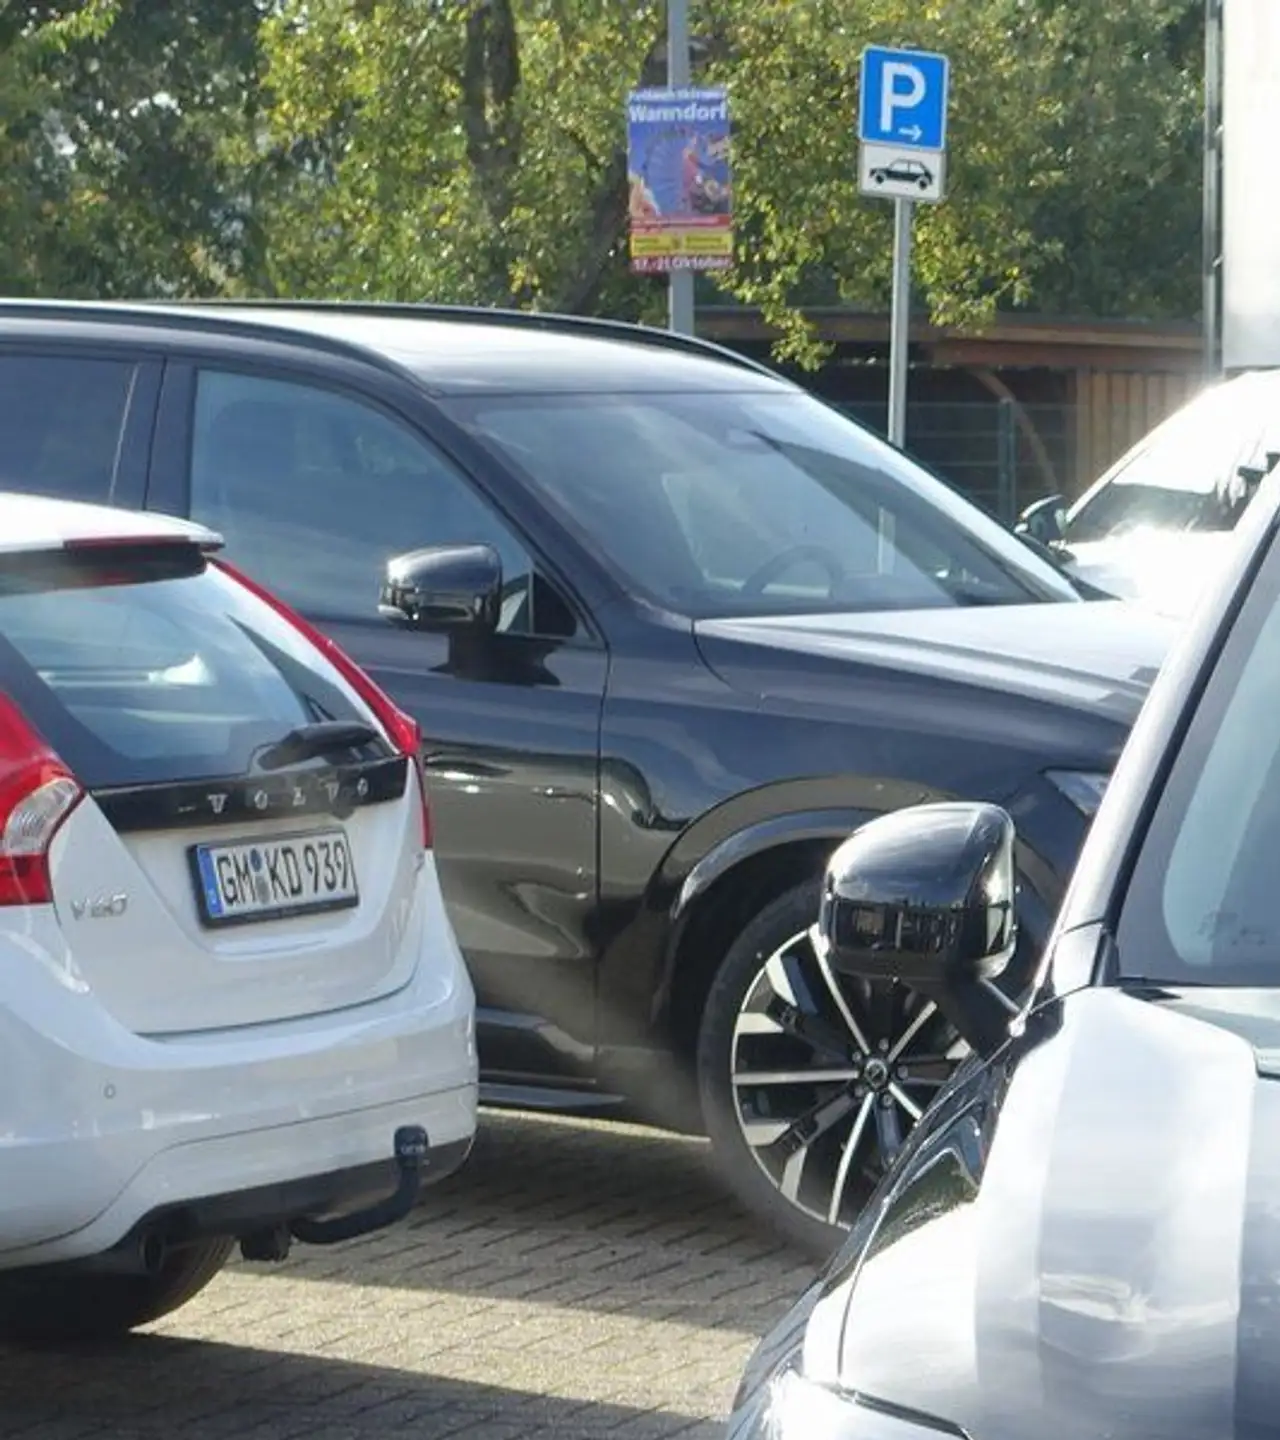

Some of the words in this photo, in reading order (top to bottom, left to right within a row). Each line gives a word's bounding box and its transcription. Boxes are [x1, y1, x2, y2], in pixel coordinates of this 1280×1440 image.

[881, 61, 926, 132] P
[207, 777, 369, 814] VOLVO
[265, 847, 302, 899] KD
[304, 840, 349, 894] 939
